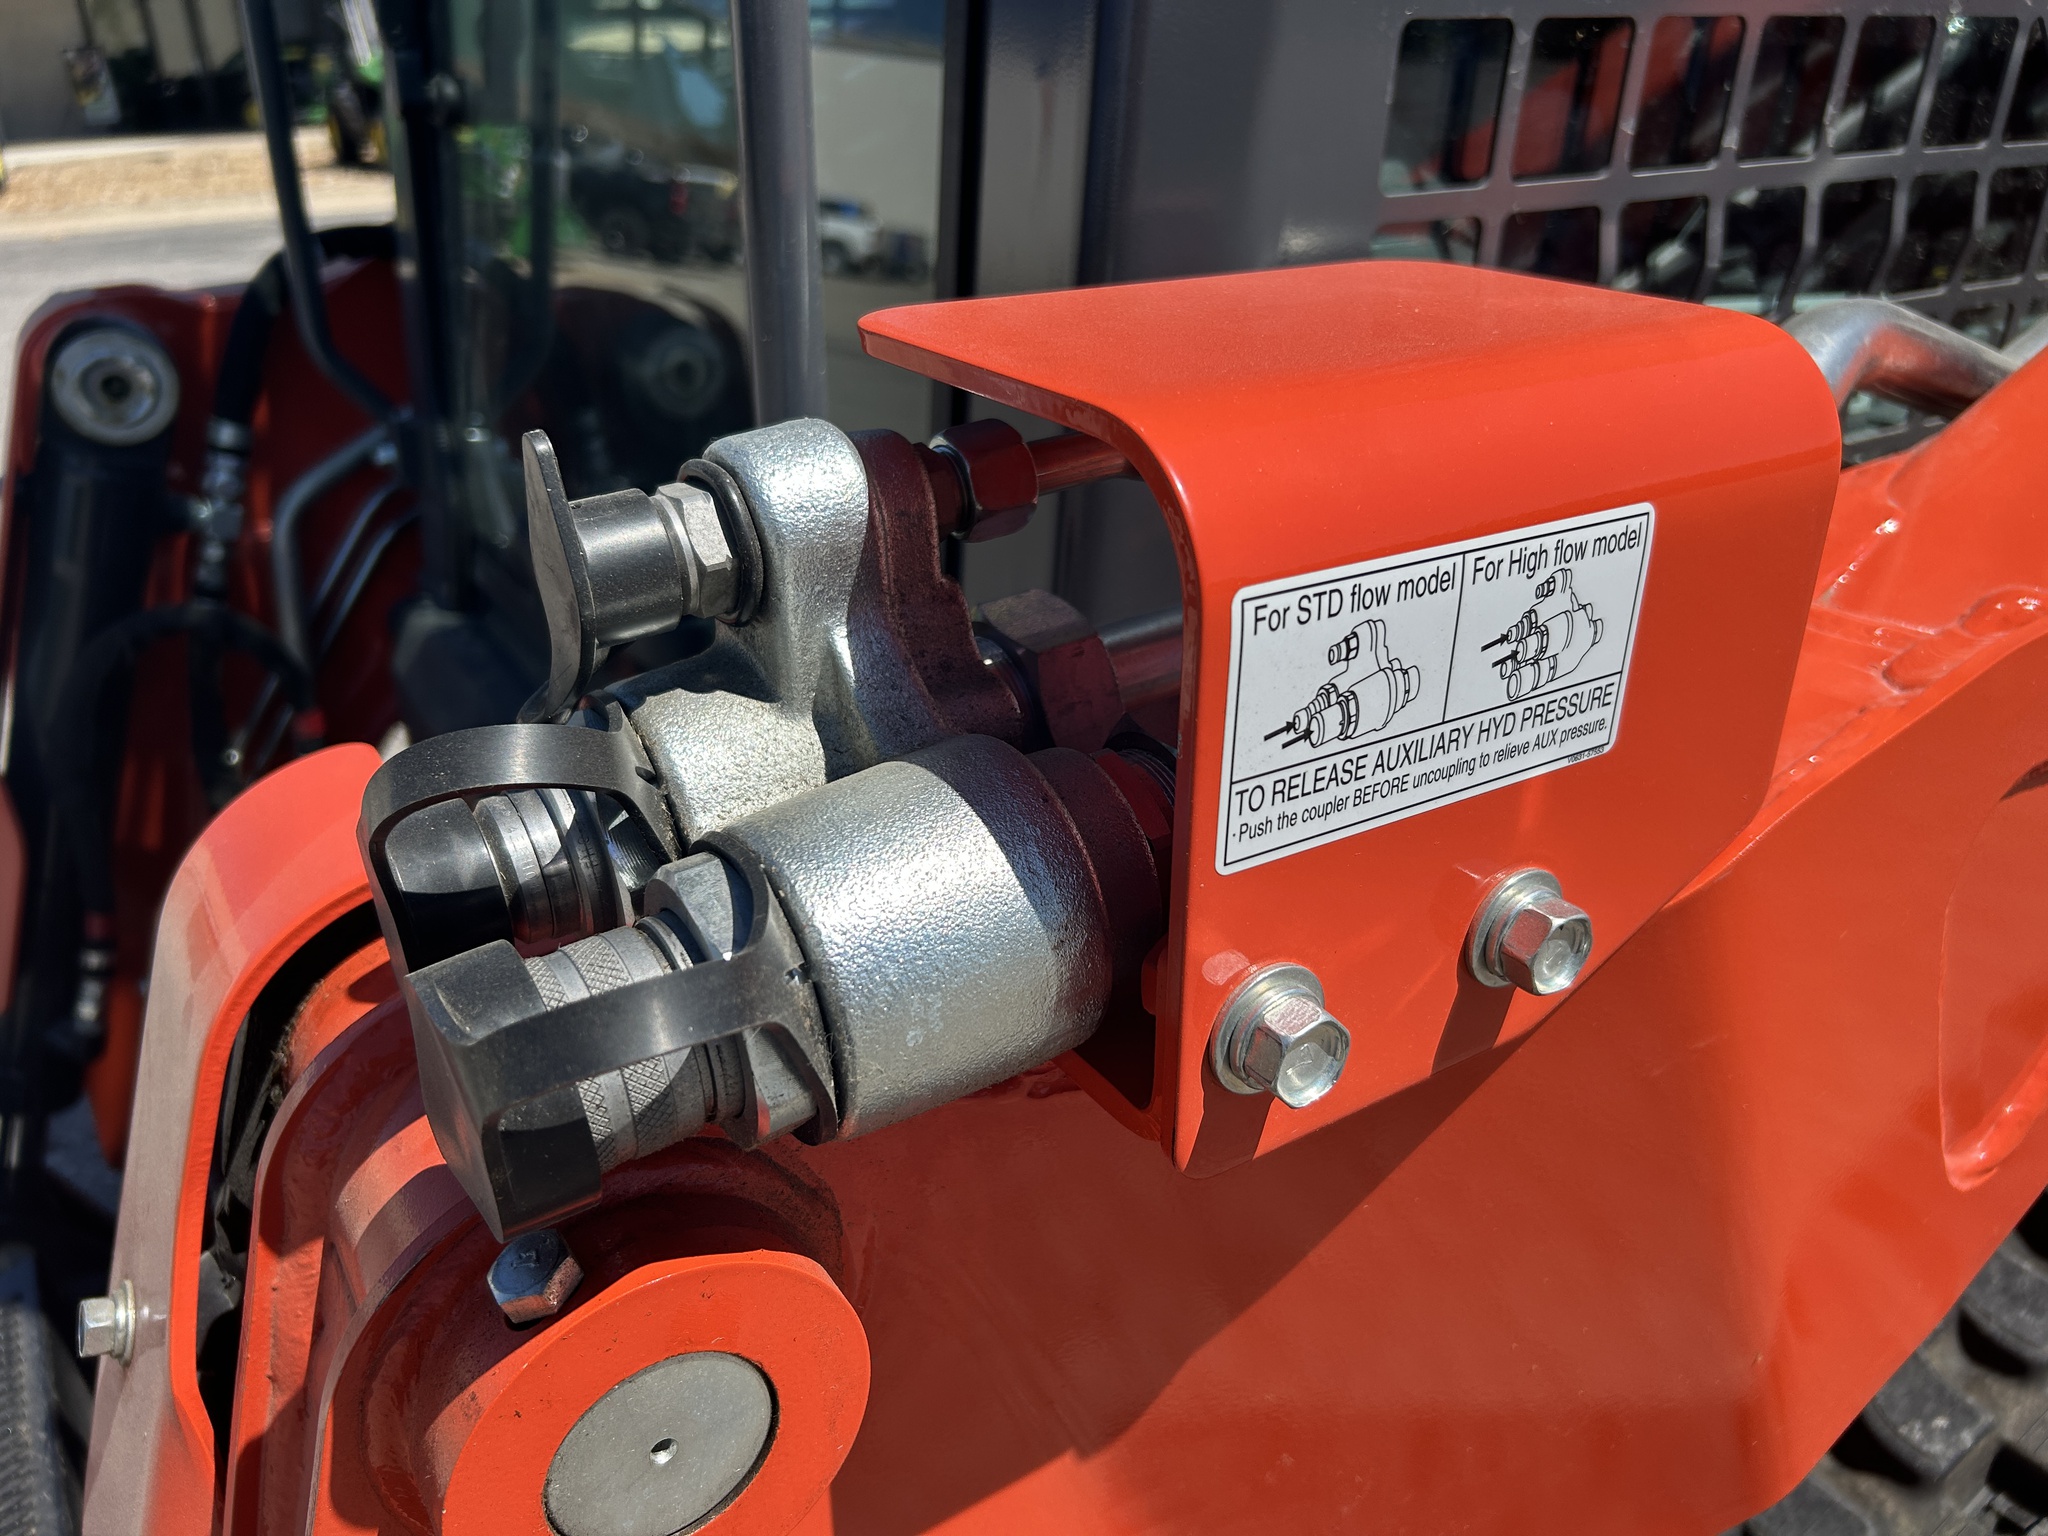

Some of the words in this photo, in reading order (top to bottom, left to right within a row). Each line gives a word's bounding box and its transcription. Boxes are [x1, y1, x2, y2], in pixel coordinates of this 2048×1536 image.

[1254, 604, 1290, 635] For
[1297, 589, 1343, 625] STD
[1350, 583, 1391, 613] flow
[1396, 562, 1456, 603] model
[1472, 556, 1504, 585] For
[1508, 543, 1549, 579] High
[1554, 539, 1588, 567] flow
[1592, 522, 1643, 557] model
[1235, 785, 1265, 816] TO
[1271, 754, 1368, 806] RELEASE
[1371, 723, 1475, 776] AUXILIARY
[1477, 712, 1516, 745] HYD
[1520, 682, 1615, 732] PRESSURE
[1277, 811, 1298, 830] the
[1302, 795, 1350, 823] coupler
[1352, 774, 1410, 808] BEFORE
[1412, 757, 1476, 789] uncoupling
[1479, 752, 1490, 769] to
[1493, 740, 1530, 765] relieve
[1532, 728, 1559, 752] AUX
[1559, 717, 1607, 748] pressure.
